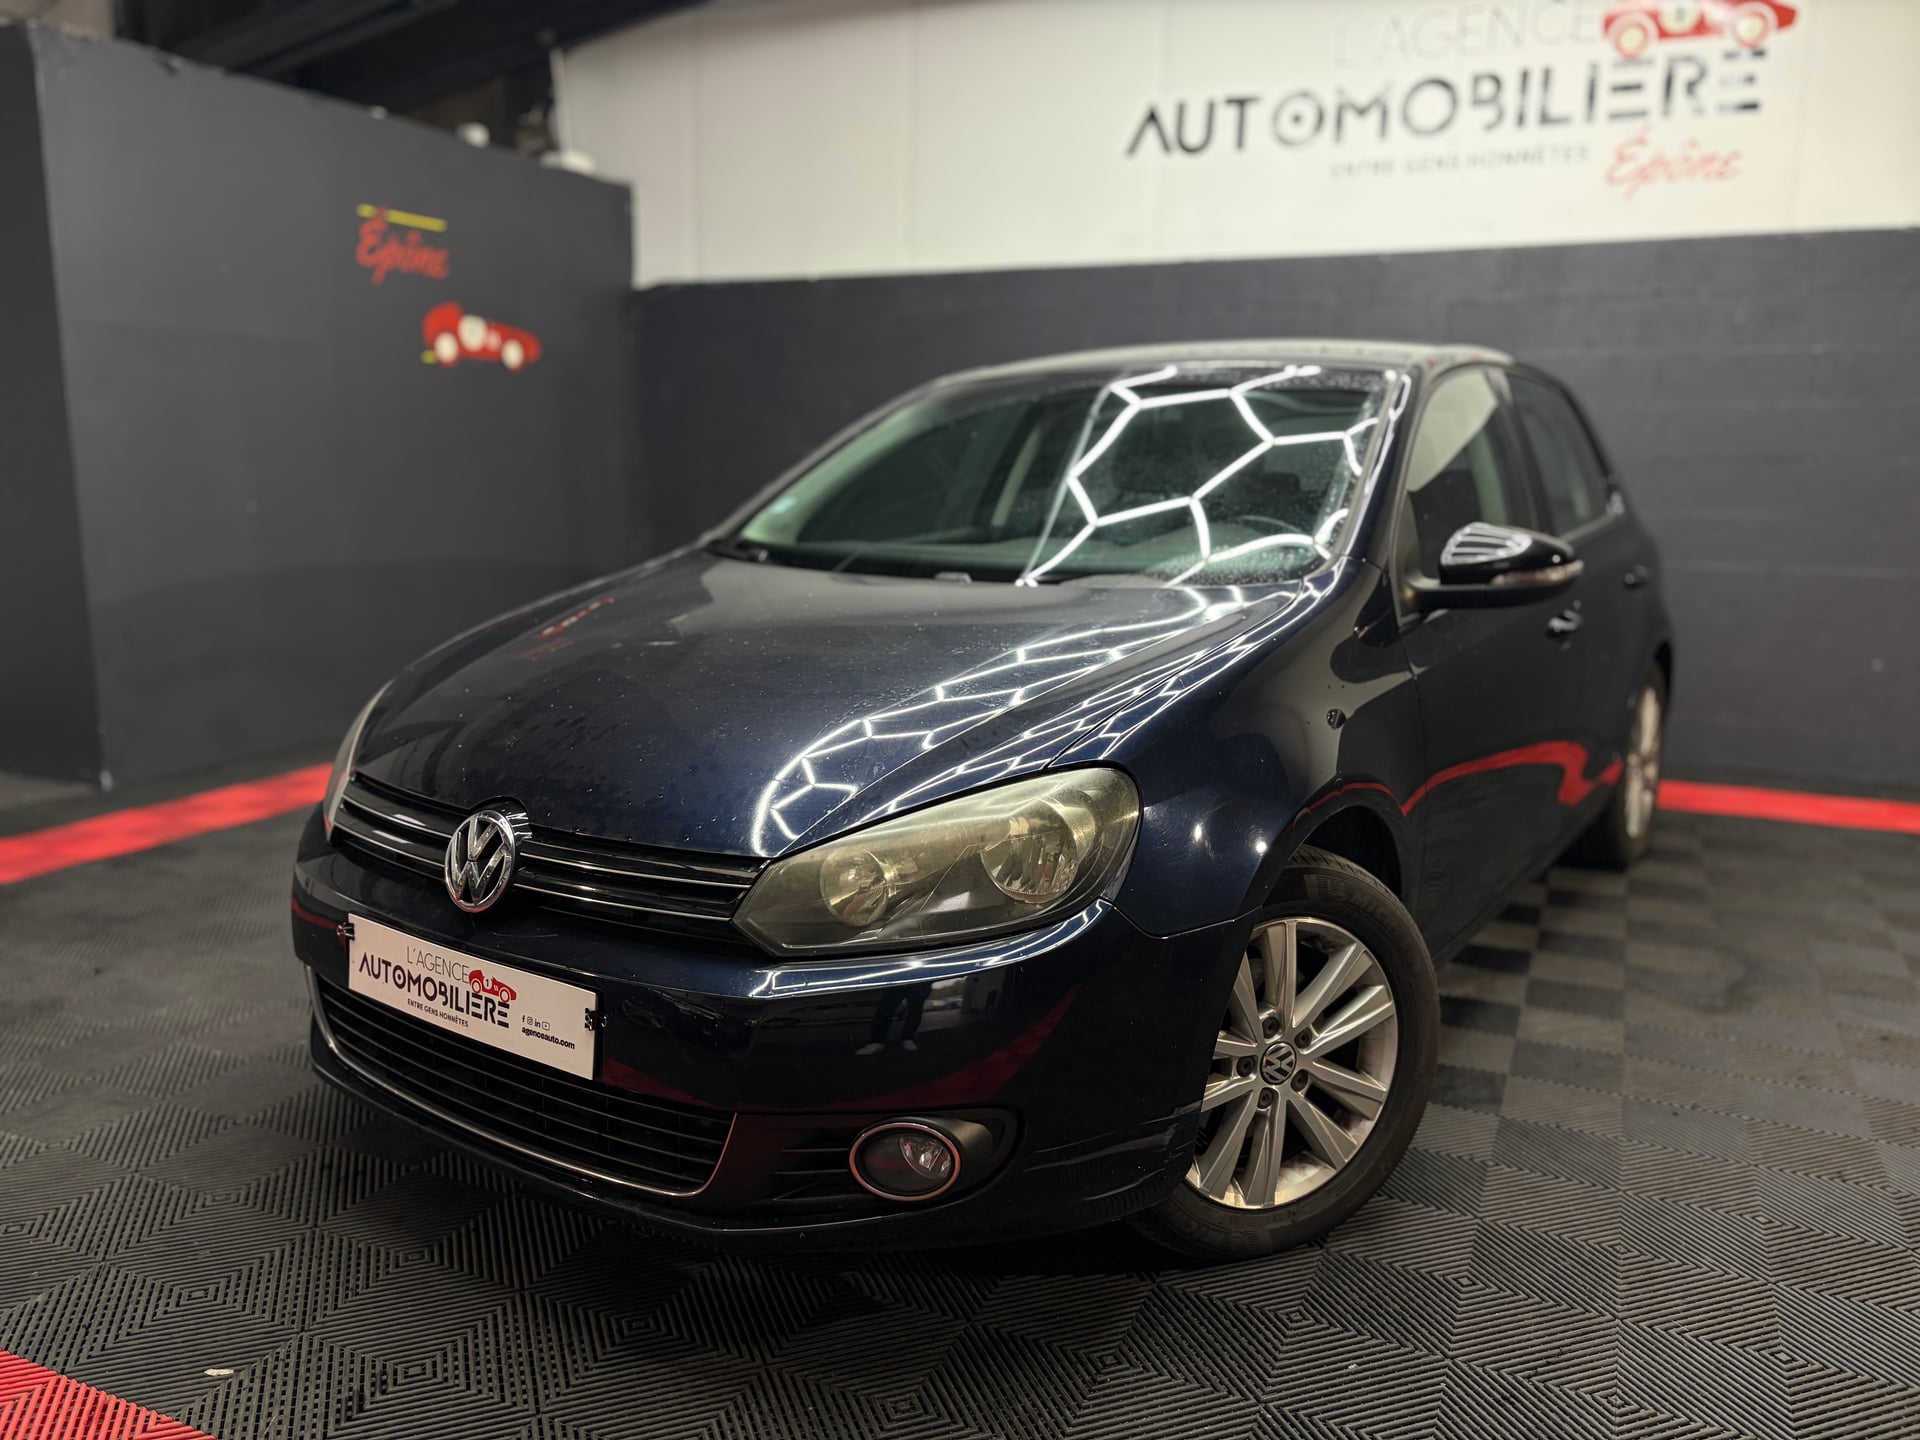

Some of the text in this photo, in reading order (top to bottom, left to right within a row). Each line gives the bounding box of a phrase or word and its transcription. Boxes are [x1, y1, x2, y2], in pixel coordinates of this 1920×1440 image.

[406, 945, 470, 984] L'AGENCE
[407, 998, 424, 1011] ENTRE
[424, 1005, 439, 1017] GENS
[521, 1027, 576, 1050] agenceauto.com
